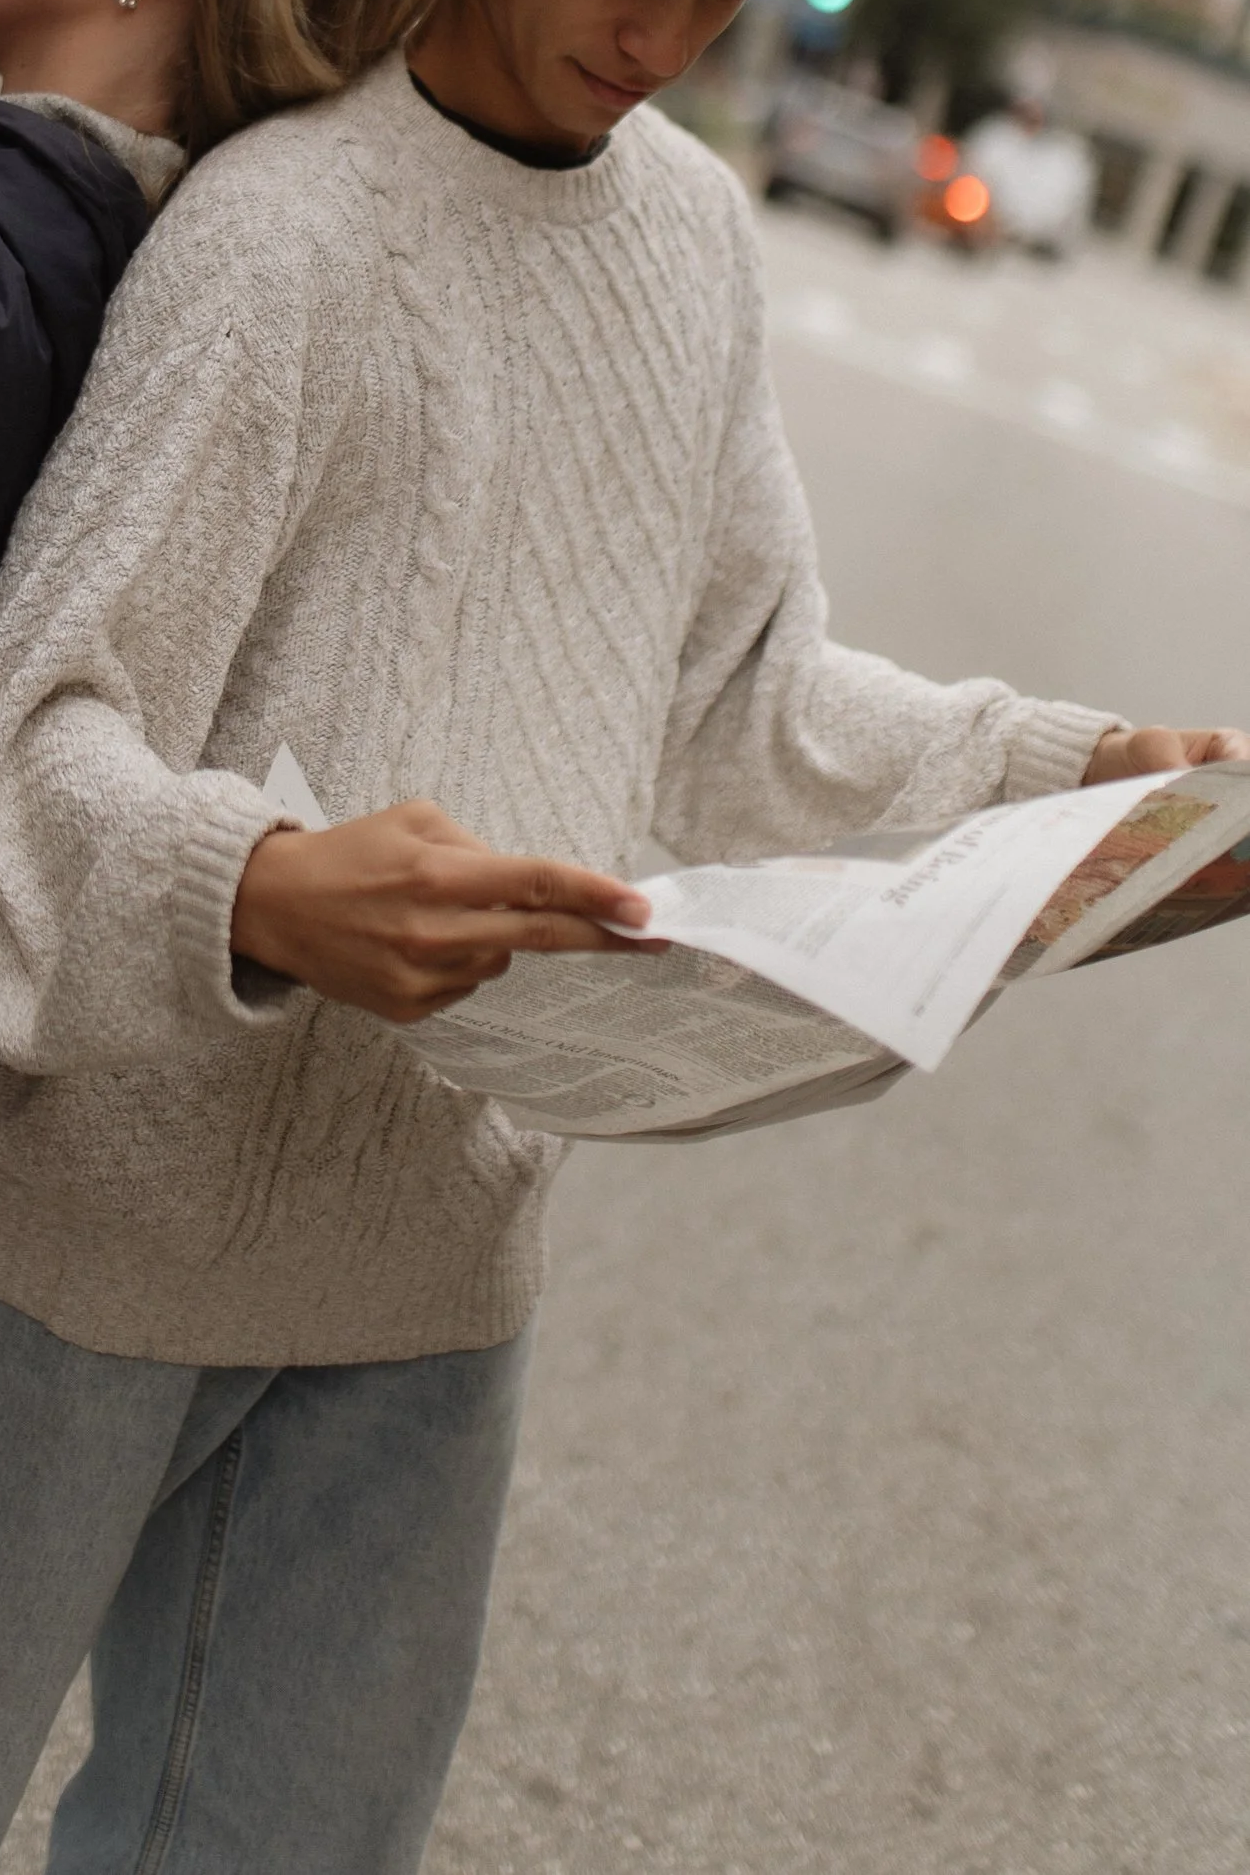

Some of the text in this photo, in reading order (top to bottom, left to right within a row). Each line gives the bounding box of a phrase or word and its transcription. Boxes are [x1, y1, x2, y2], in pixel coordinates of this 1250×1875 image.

[450, 1013, 491, 1027] and
[489, 1024, 545, 1043] Other
[545, 1039, 590, 1054] Odd
